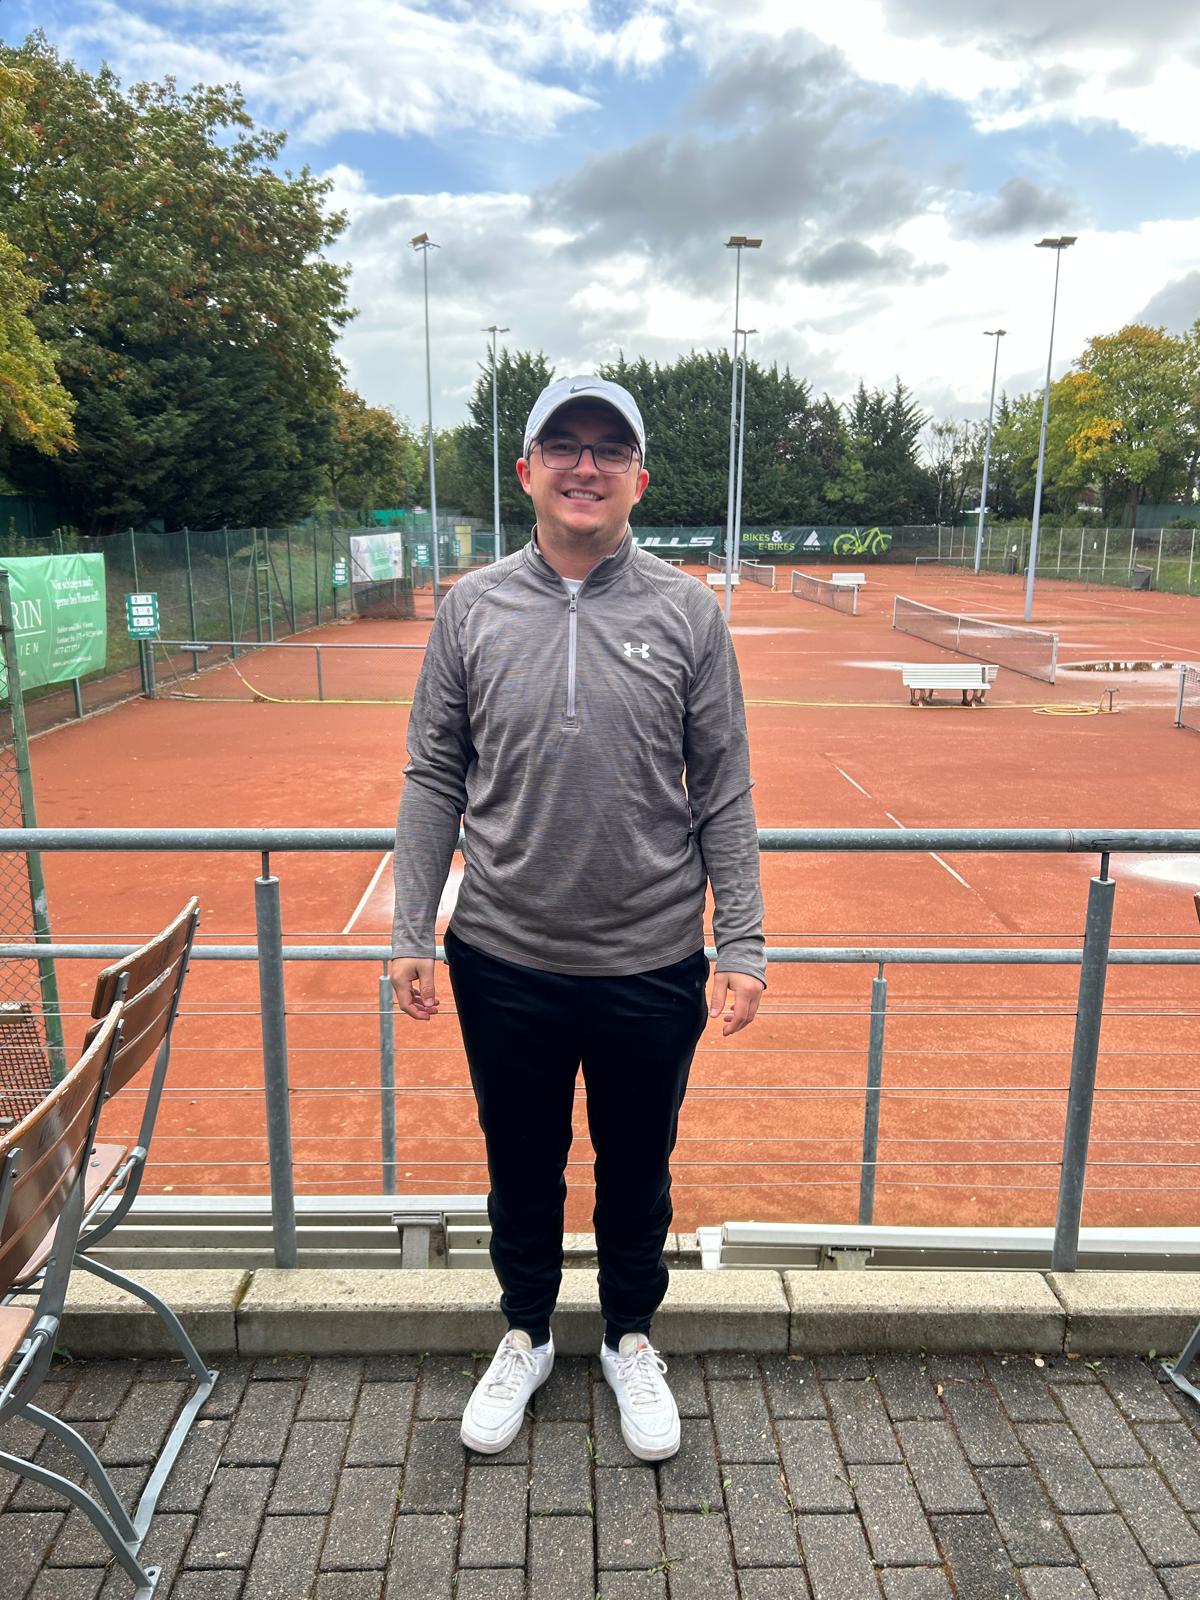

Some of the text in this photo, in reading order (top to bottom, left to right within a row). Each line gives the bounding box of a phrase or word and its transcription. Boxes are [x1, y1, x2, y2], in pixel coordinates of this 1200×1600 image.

[632, 537, 715, 547] ULLS
[742, 530, 783, 543] BIKES &
[758, 543, 795, 551] E-BIKES
[11, 598, 42, 630] RIN
[20, 641, 39, 657] IEN
